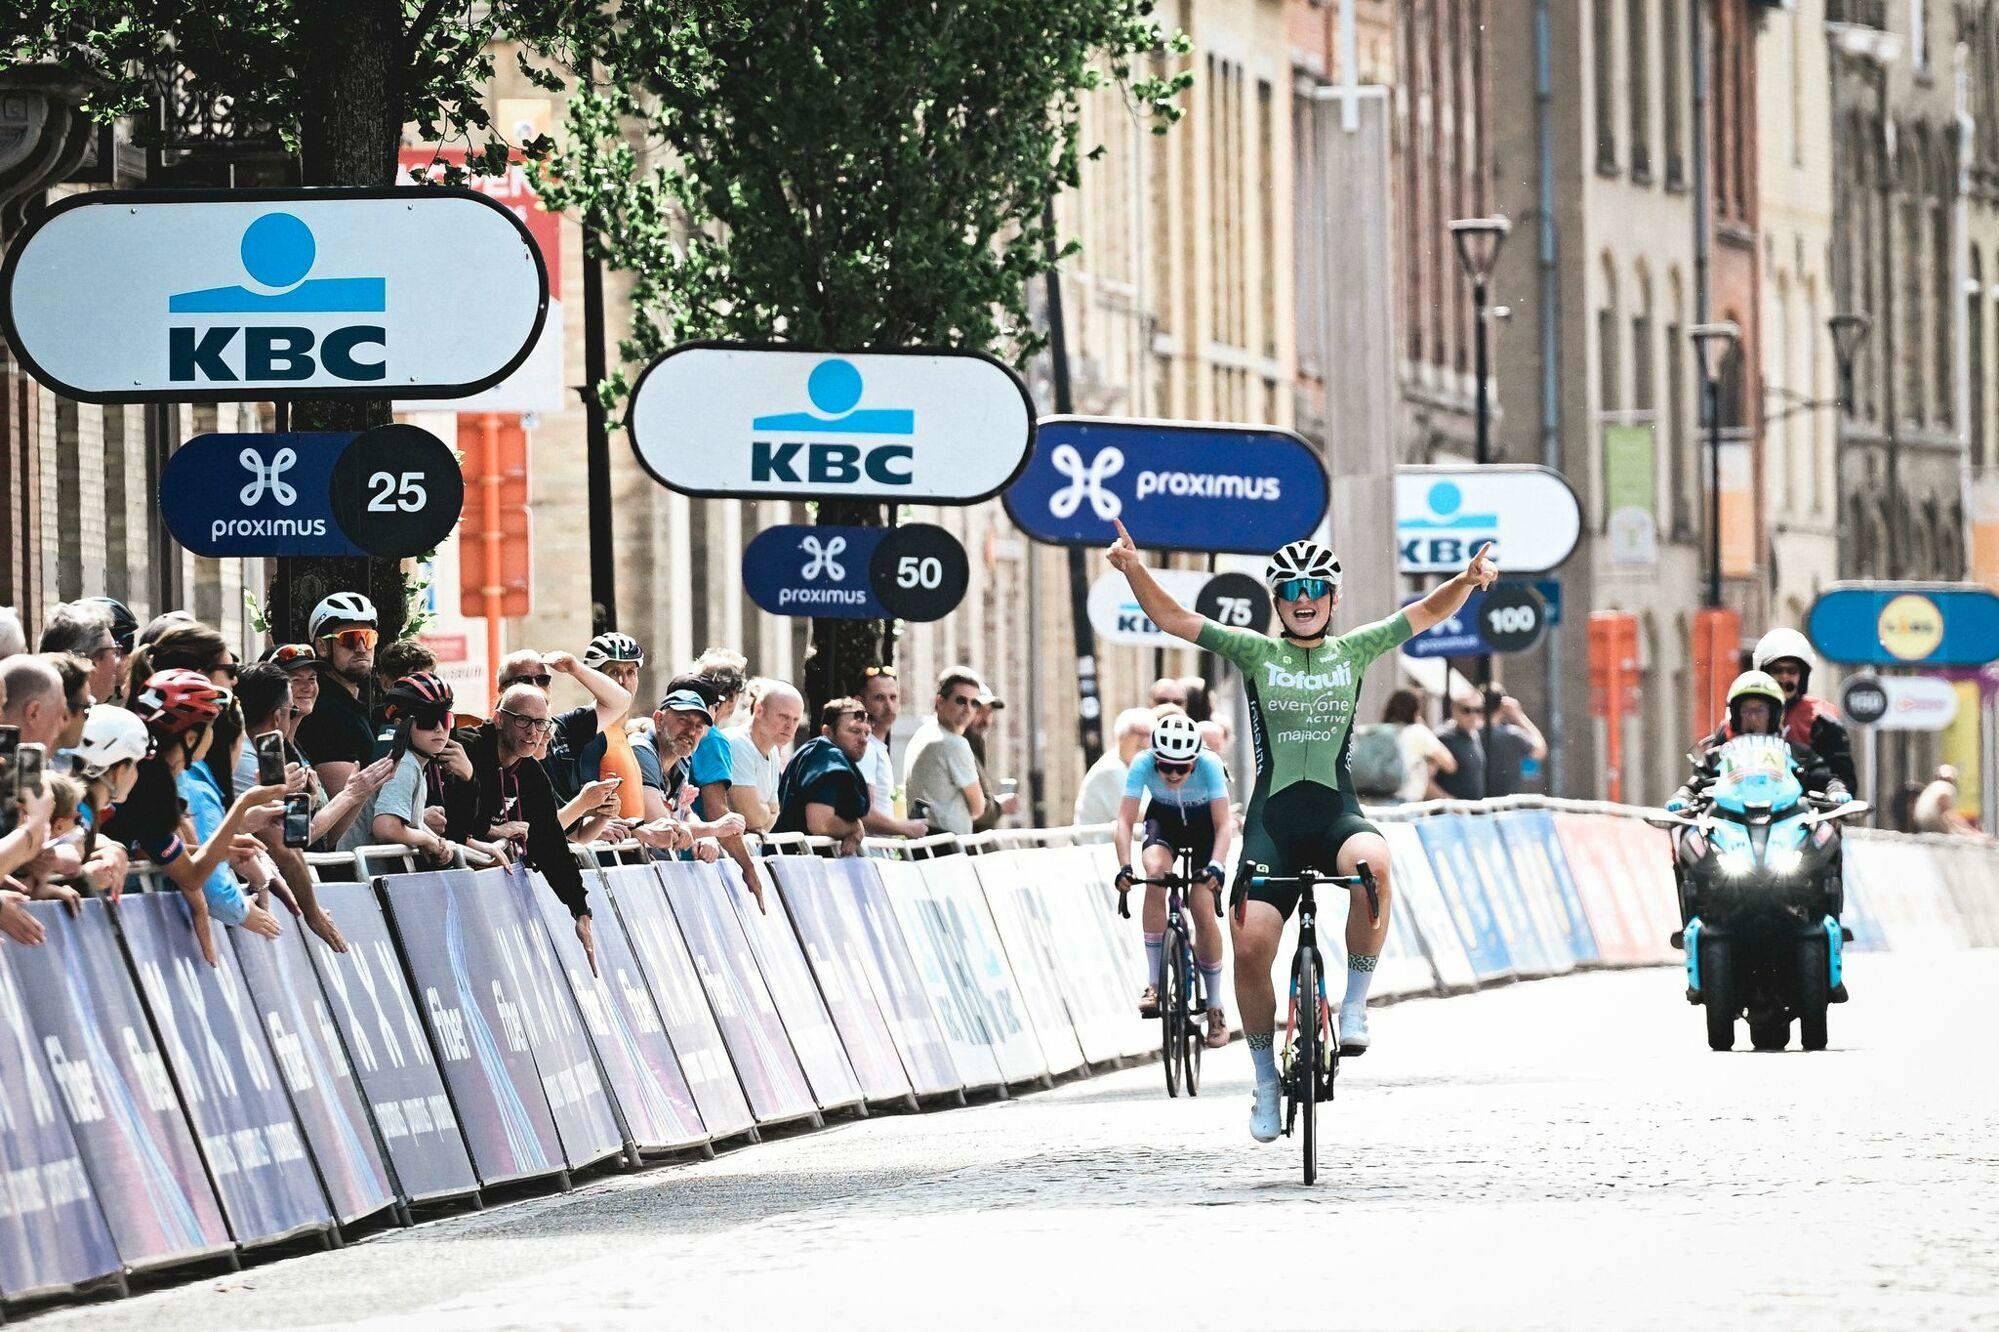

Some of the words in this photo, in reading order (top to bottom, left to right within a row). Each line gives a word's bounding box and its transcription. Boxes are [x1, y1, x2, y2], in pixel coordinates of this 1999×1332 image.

[169, 325, 386, 382] KBC
[751, 442, 914, 485] KBC
[367, 471, 428, 513] 25
[1136, 469, 1281, 501] proximus
[211, 518, 326, 542] proximus
[897, 556, 943, 589] 50
[779, 588, 867, 606] proximus
[1215, 596, 1253, 627] 75
[1488, 604, 1536, 634] 100
[1268, 690, 1350, 716] everyone
[1306, 715, 1347, 724] ACTIVE
